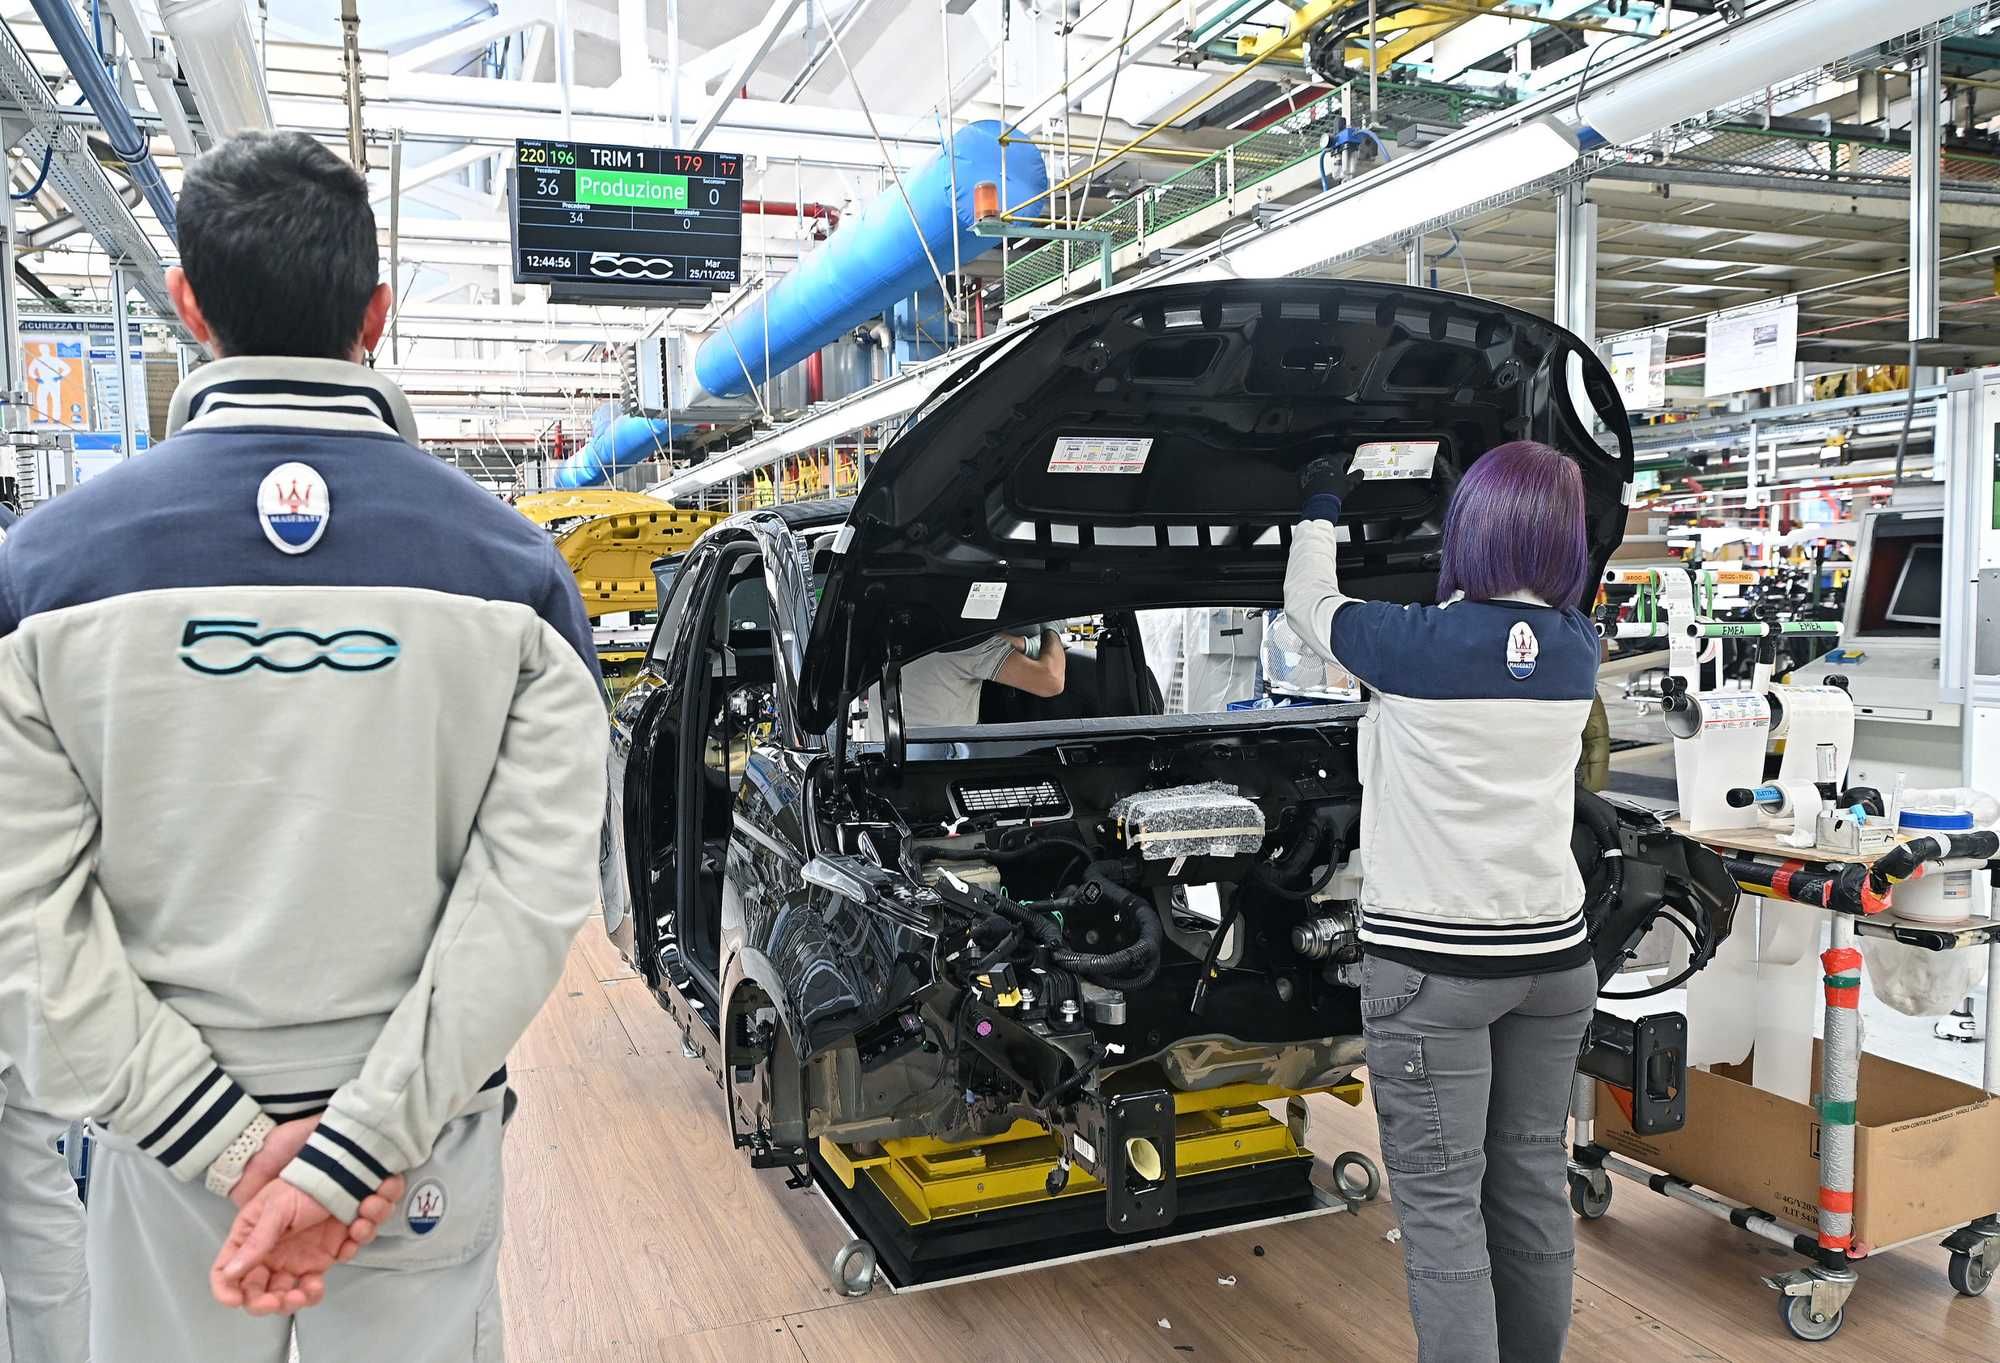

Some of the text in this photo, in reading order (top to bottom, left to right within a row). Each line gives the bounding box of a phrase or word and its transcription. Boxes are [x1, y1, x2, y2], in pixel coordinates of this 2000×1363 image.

[520, 148, 546, 163] 220
[550, 150, 575, 165] 196
[590, 149, 645, 169] TRIM 1
[673, 155, 704, 173] 179
[721, 162, 736, 176] 17
[536, 178, 559, 196] 36
[579, 176, 686, 201] Produzione
[708, 188, 720, 206] 0
[569, 212, 584, 224] 34
[683, 218, 691, 230] 0
[526, 255, 572, 268] 12:44:56
[589, 251, 674, 280] 500
[705, 259, 721, 269] Mar
[689, 268, 736, 281] 25/11/2025
[270, 514, 321, 524] MASERATI
[1722, 625, 1745, 636] EMEA
[181, 620, 399, 676] 500
[1509, 661, 1534, 669] MASERATI
